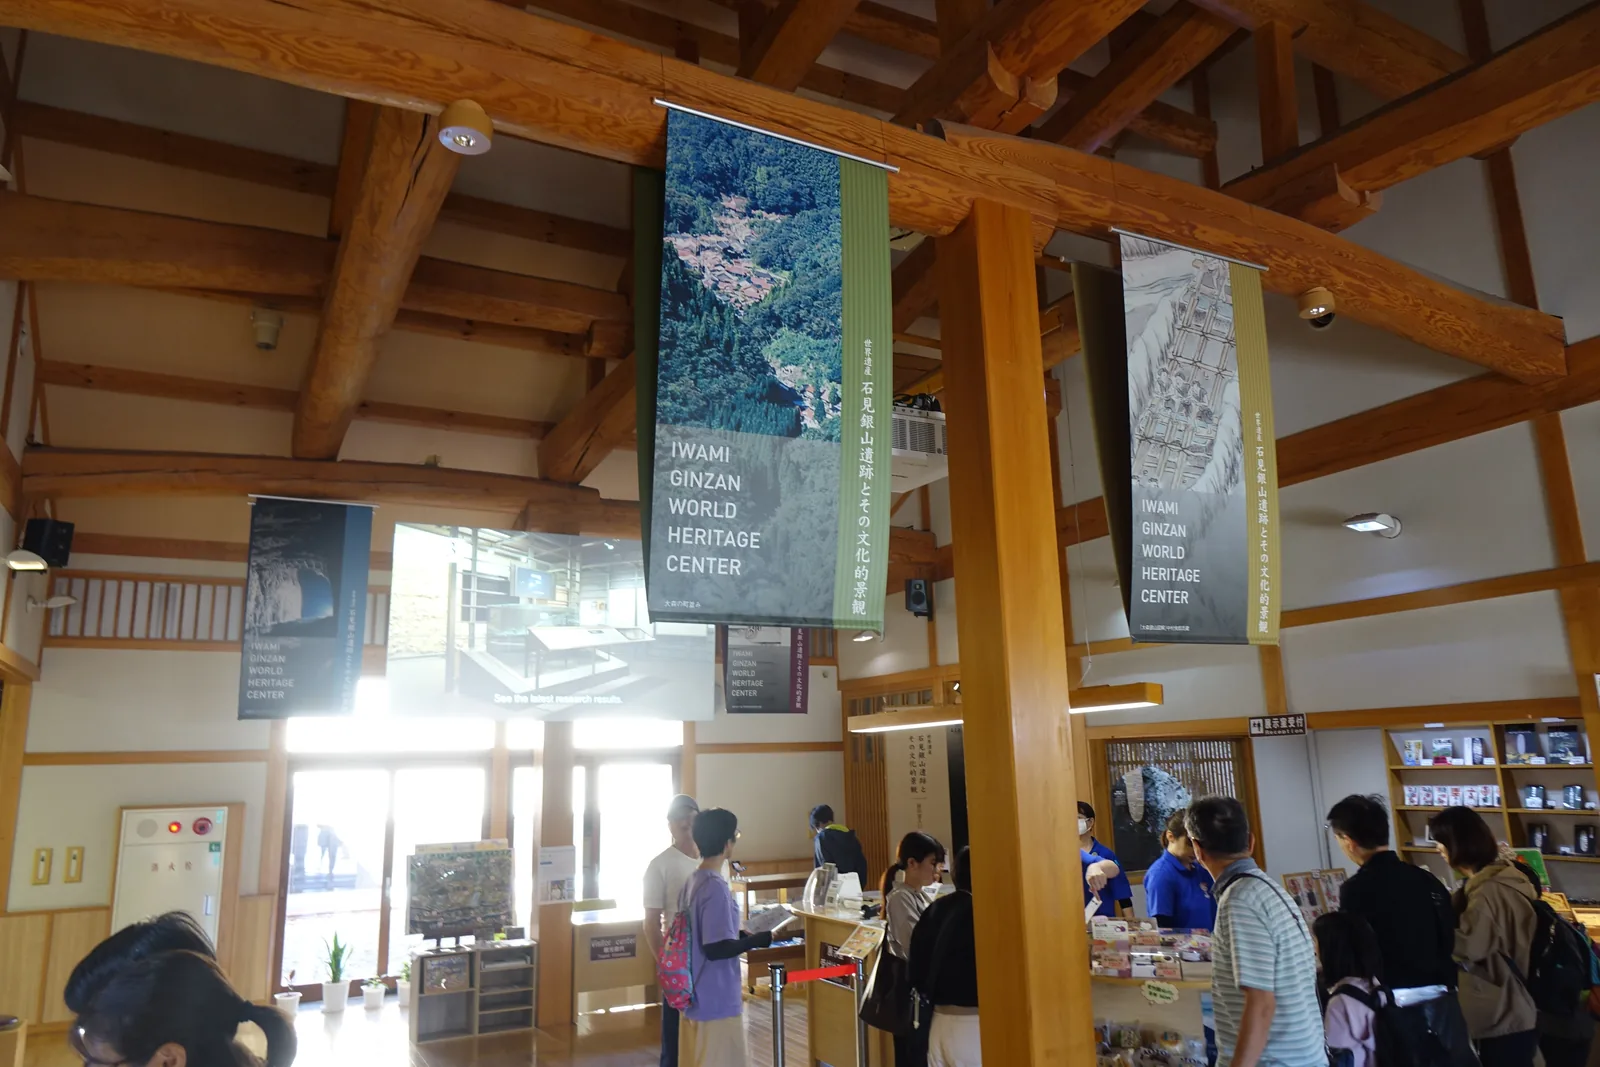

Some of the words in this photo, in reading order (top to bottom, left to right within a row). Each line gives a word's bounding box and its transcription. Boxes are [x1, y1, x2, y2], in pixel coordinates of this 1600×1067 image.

[863, 339, 873, 376] 世界遺産
[671, 441, 730, 464] IWAMI
[670, 470, 741, 492] GINZAN
[851, 381, 875, 615] 石見銀山遺跡とその文化的景観
[668, 497, 737, 519] WORLD
[1141, 499, 1179, 515] IWAMI
[667, 525, 761, 549] HERITAGE
[1141, 521, 1187, 538] GINZAN
[1141, 543, 1185, 560] WORLD
[666, 554, 741, 576] CENTER
[1141, 566, 1201, 583] HERITAGE
[664, 599, 702, 608] 大森の町並み
[1140, 589, 1189, 605] CENTER
[250, 642, 281, 651] IWAMI
[249, 654, 286, 663] GINZAN
[248, 666, 283, 675] WORLD
[247, 678, 295, 688] HERITAGE
[246, 690, 285, 700] CENTER
[494, 693, 510, 703] See
[512, 694, 529, 703] the
[530, 694, 554, 704] latest
[555, 694, 592, 704] research
[731, 689, 758, 697] CENTER
[1264, 716, 1303, 729] 展示室受付
[908, 735, 918, 794] その文化的景観
